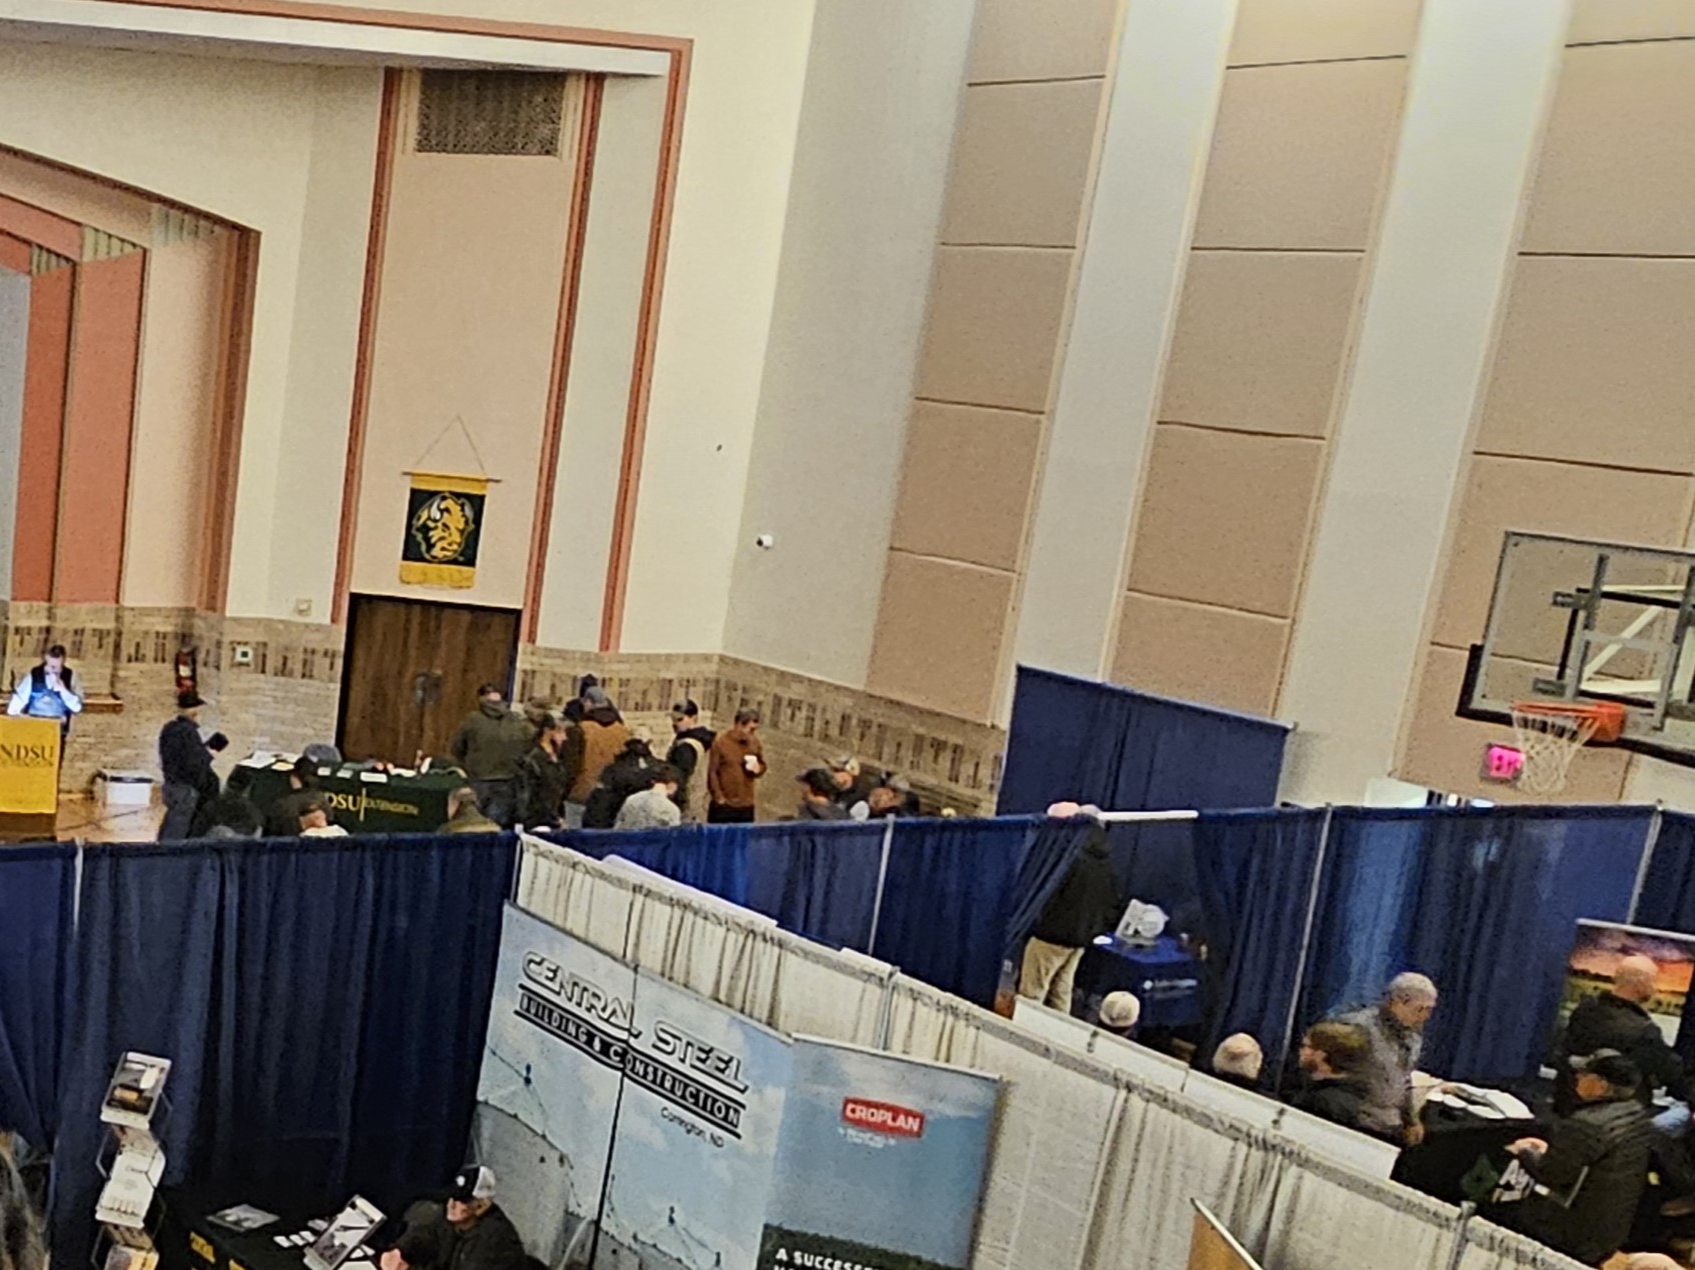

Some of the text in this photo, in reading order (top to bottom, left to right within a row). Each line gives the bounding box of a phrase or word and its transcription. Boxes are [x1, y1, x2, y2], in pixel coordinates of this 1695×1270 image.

[518, 991, 589, 1044] BUILDING
[609, 1045, 742, 1129] CONSTRUCTION
[522, 950, 749, 1095] CENTRAL STEEL
[845, 1102, 921, 1132] CROPLAN
[775, 1248, 789, 1262] A
